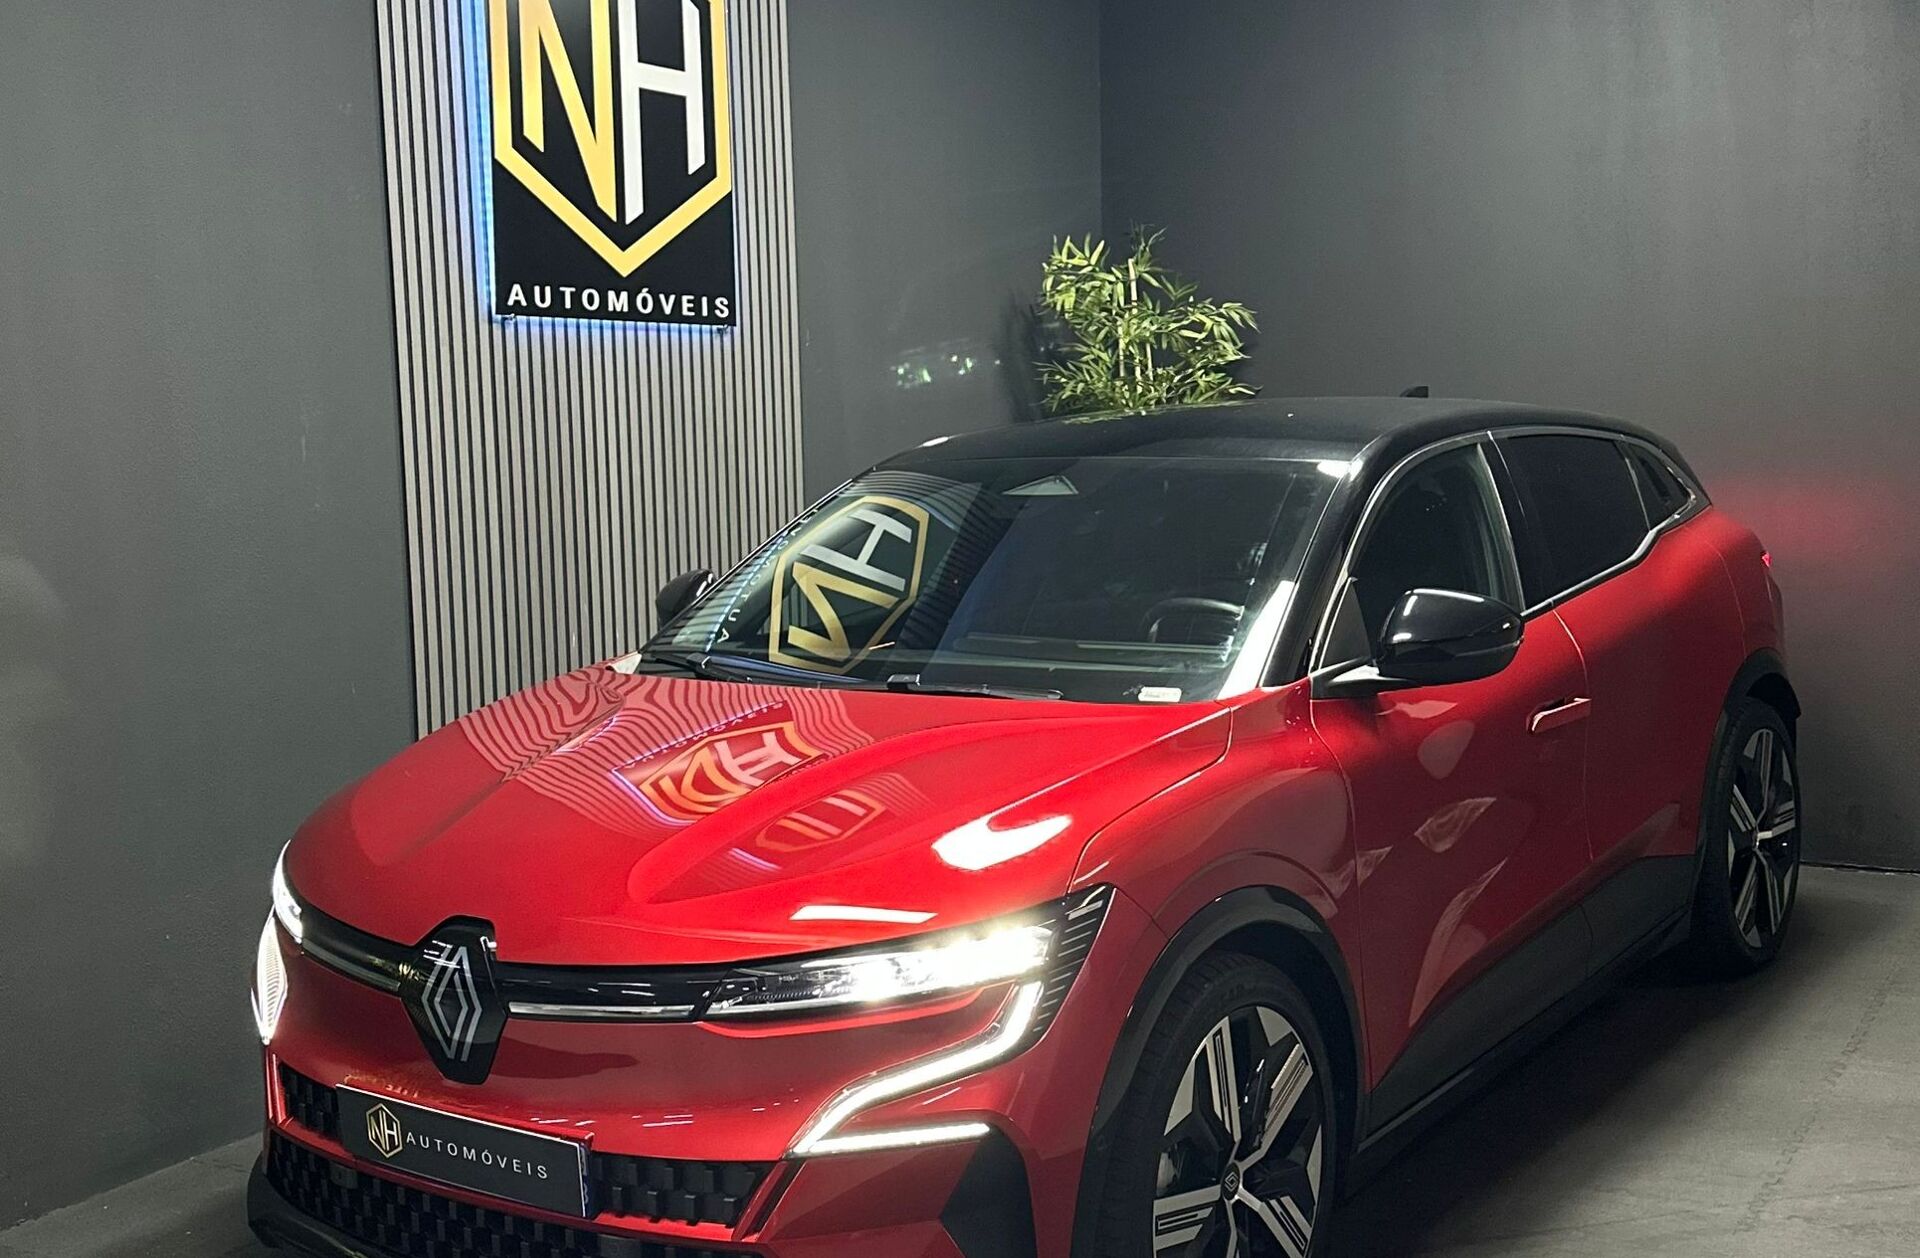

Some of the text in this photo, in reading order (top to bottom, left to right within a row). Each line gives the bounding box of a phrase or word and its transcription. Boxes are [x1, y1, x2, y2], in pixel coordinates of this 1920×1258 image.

[519, 0, 706, 226] NH
[507, 283, 730, 318] AUTOMÓVEIS
[406, 1131, 548, 1180] AUTOMÓVEIS
